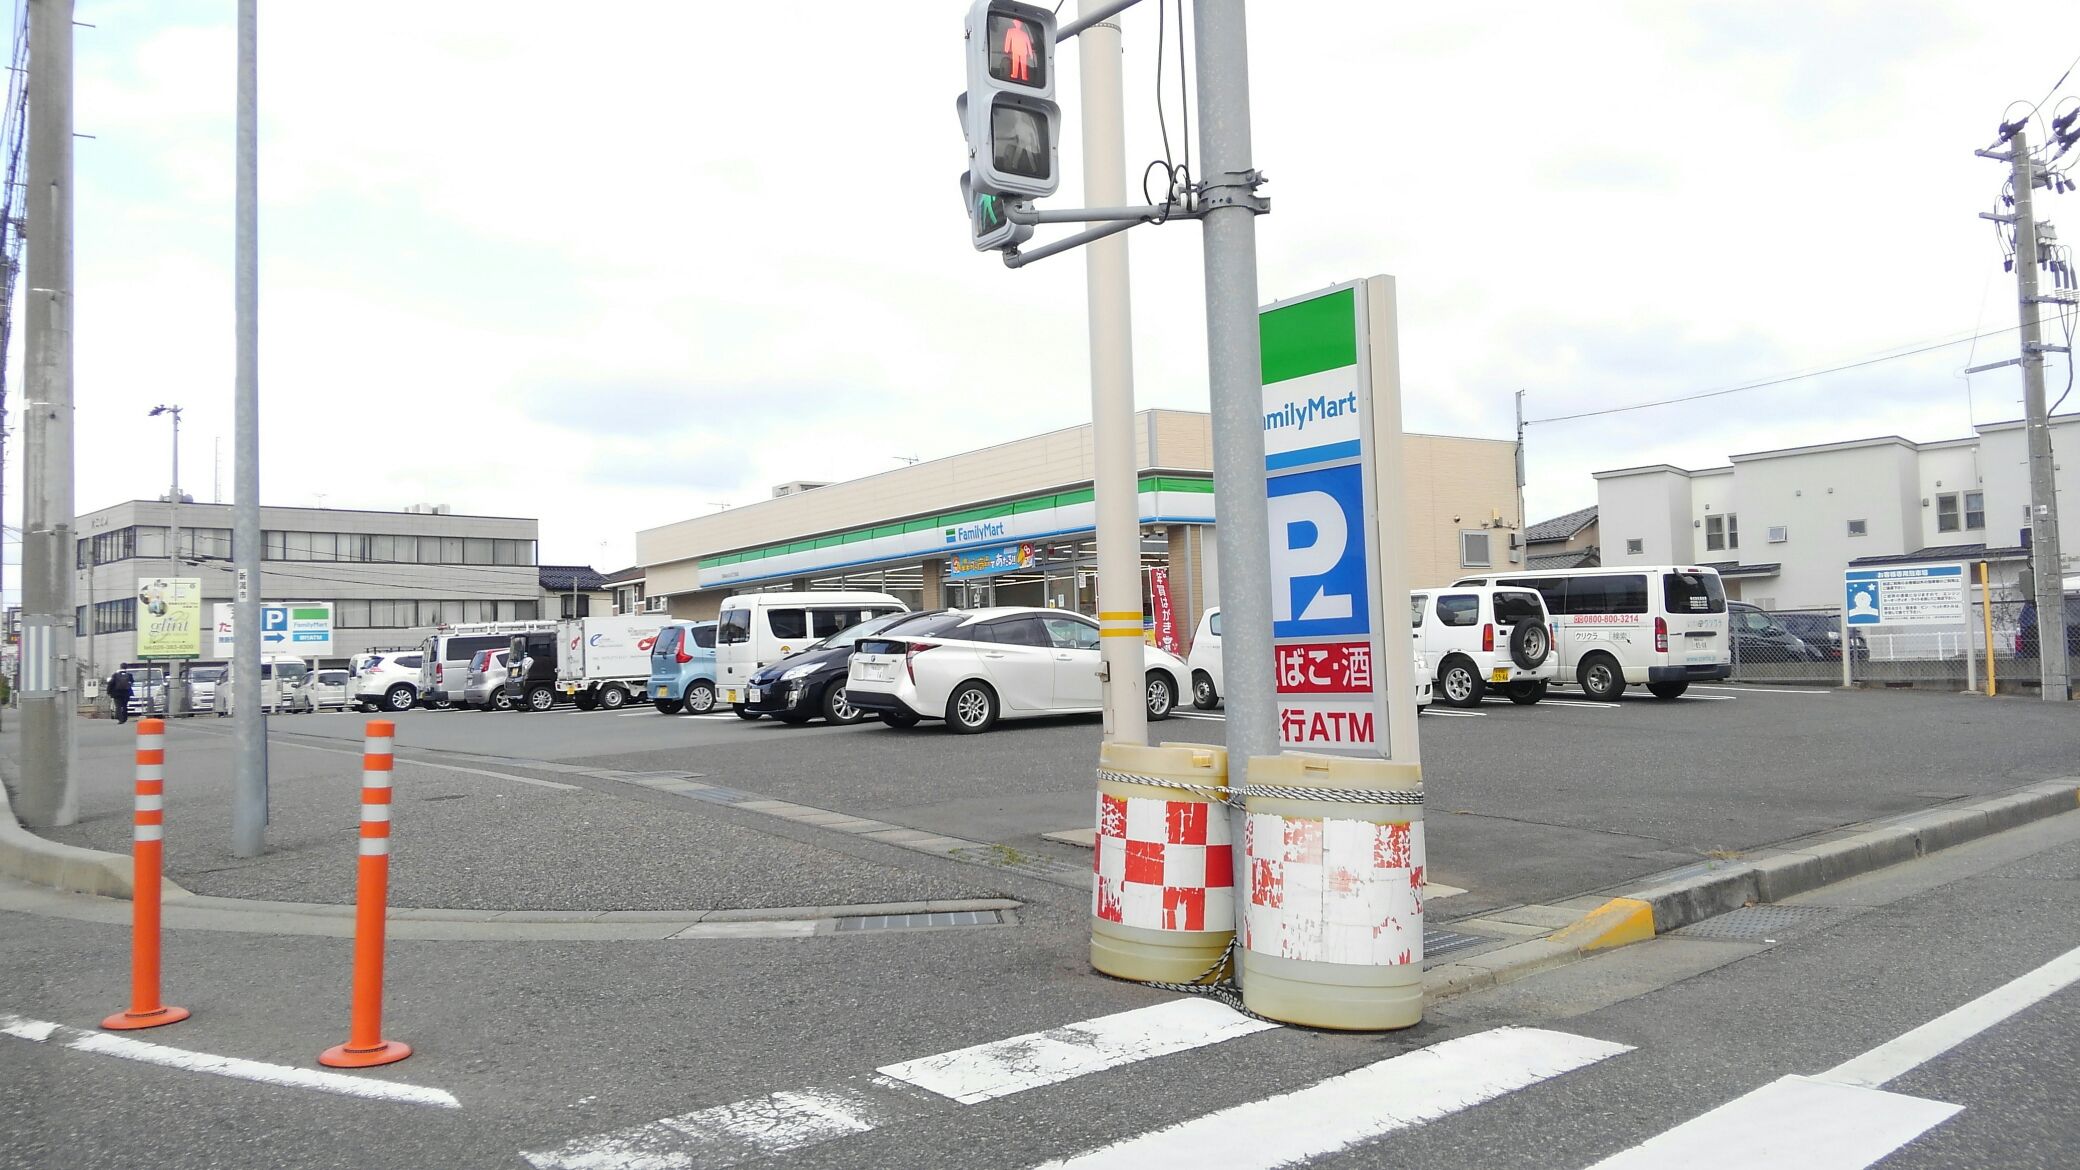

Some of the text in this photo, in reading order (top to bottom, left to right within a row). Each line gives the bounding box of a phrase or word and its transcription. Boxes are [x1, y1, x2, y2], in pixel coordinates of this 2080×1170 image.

[958, 522, 1005, 542] FamilyMart
[266, 610, 284, 630] P
[1584, 614, 1639, 624] 0800-800-3214
[1275, 647, 1371, 687] ばこ・酒
[1279, 708, 1375, 743] 行ATM
